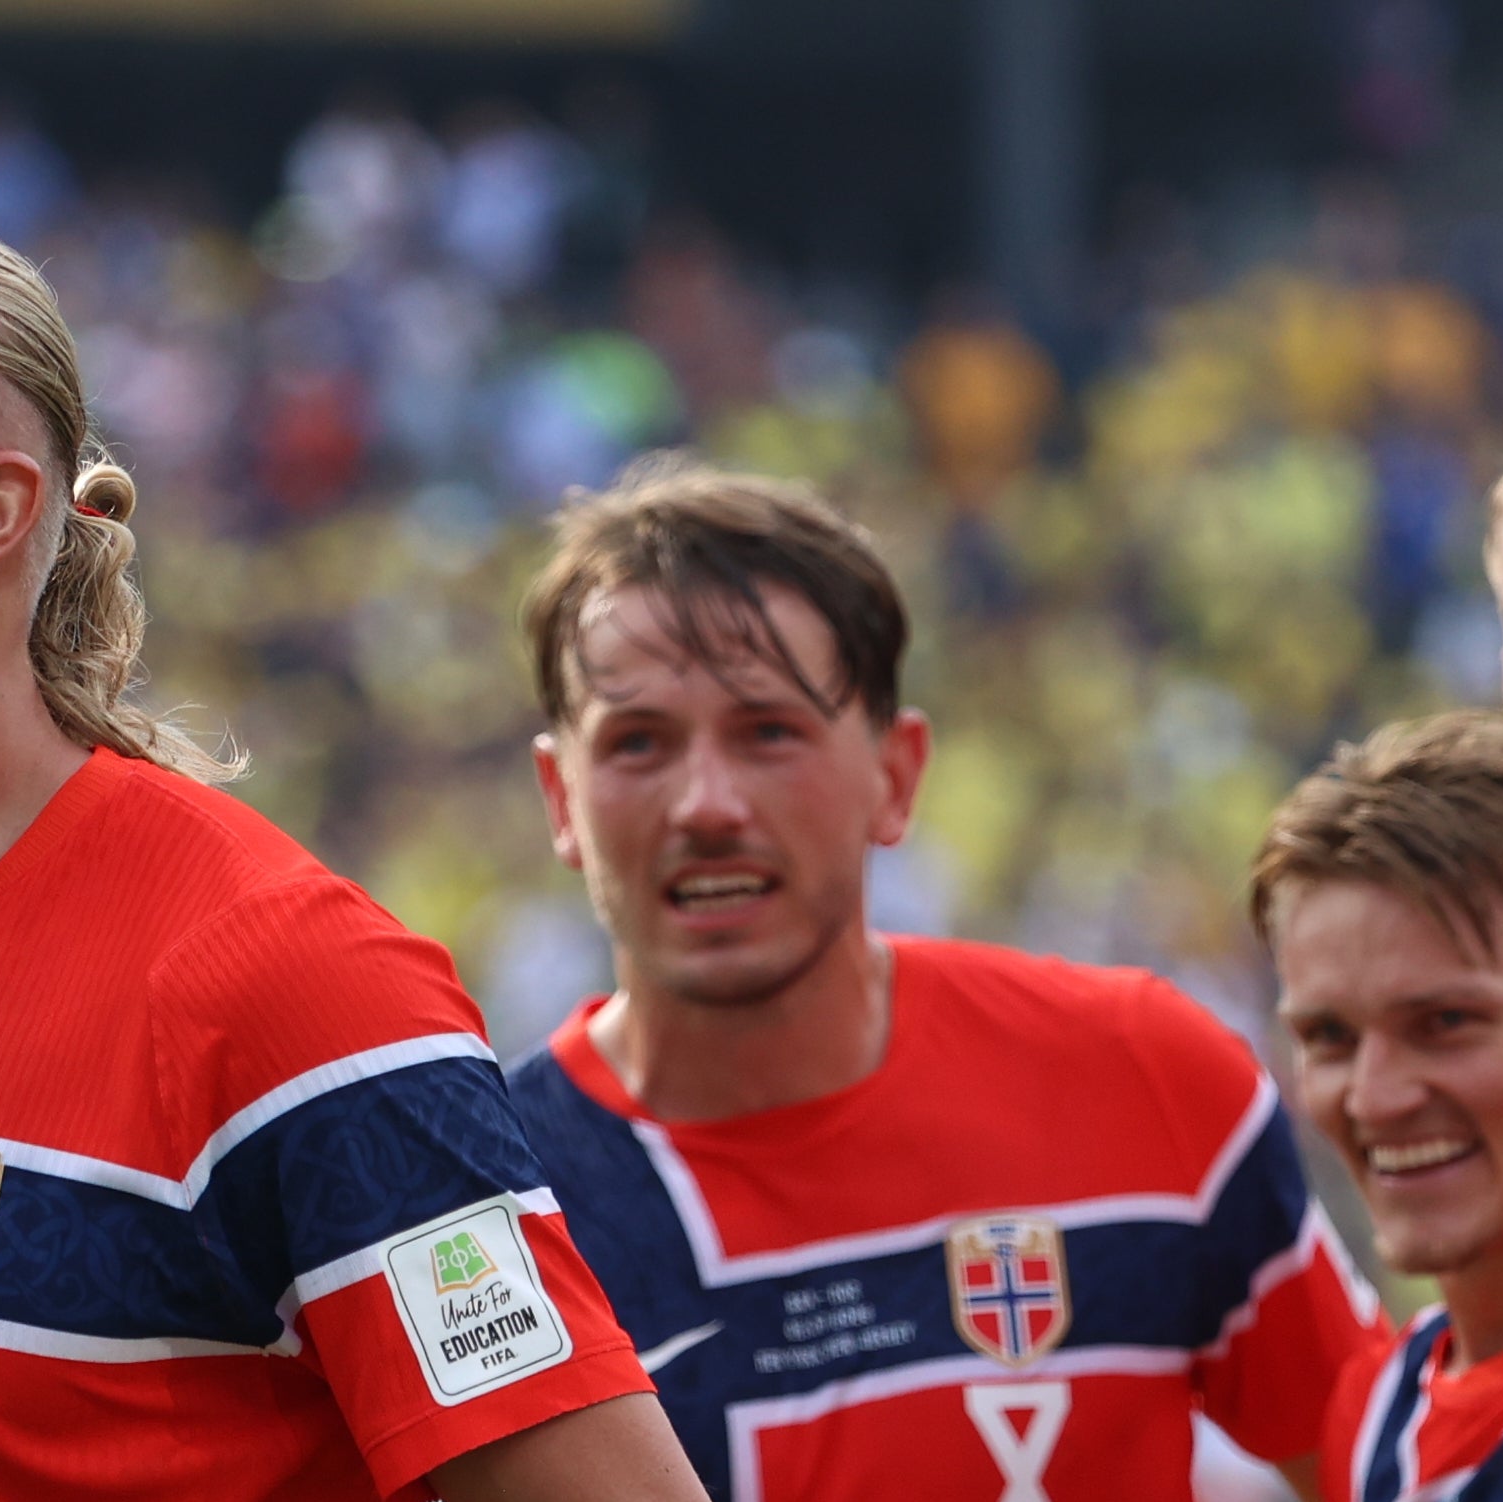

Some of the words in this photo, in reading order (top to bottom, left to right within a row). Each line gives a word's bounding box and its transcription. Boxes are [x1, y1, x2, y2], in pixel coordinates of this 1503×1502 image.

[441, 1293, 488, 1331] Unite
[484, 1280, 513, 1313] For
[439, 1305, 539, 1365] EDUCATION
[480, 1347, 517, 1371] FIFA
